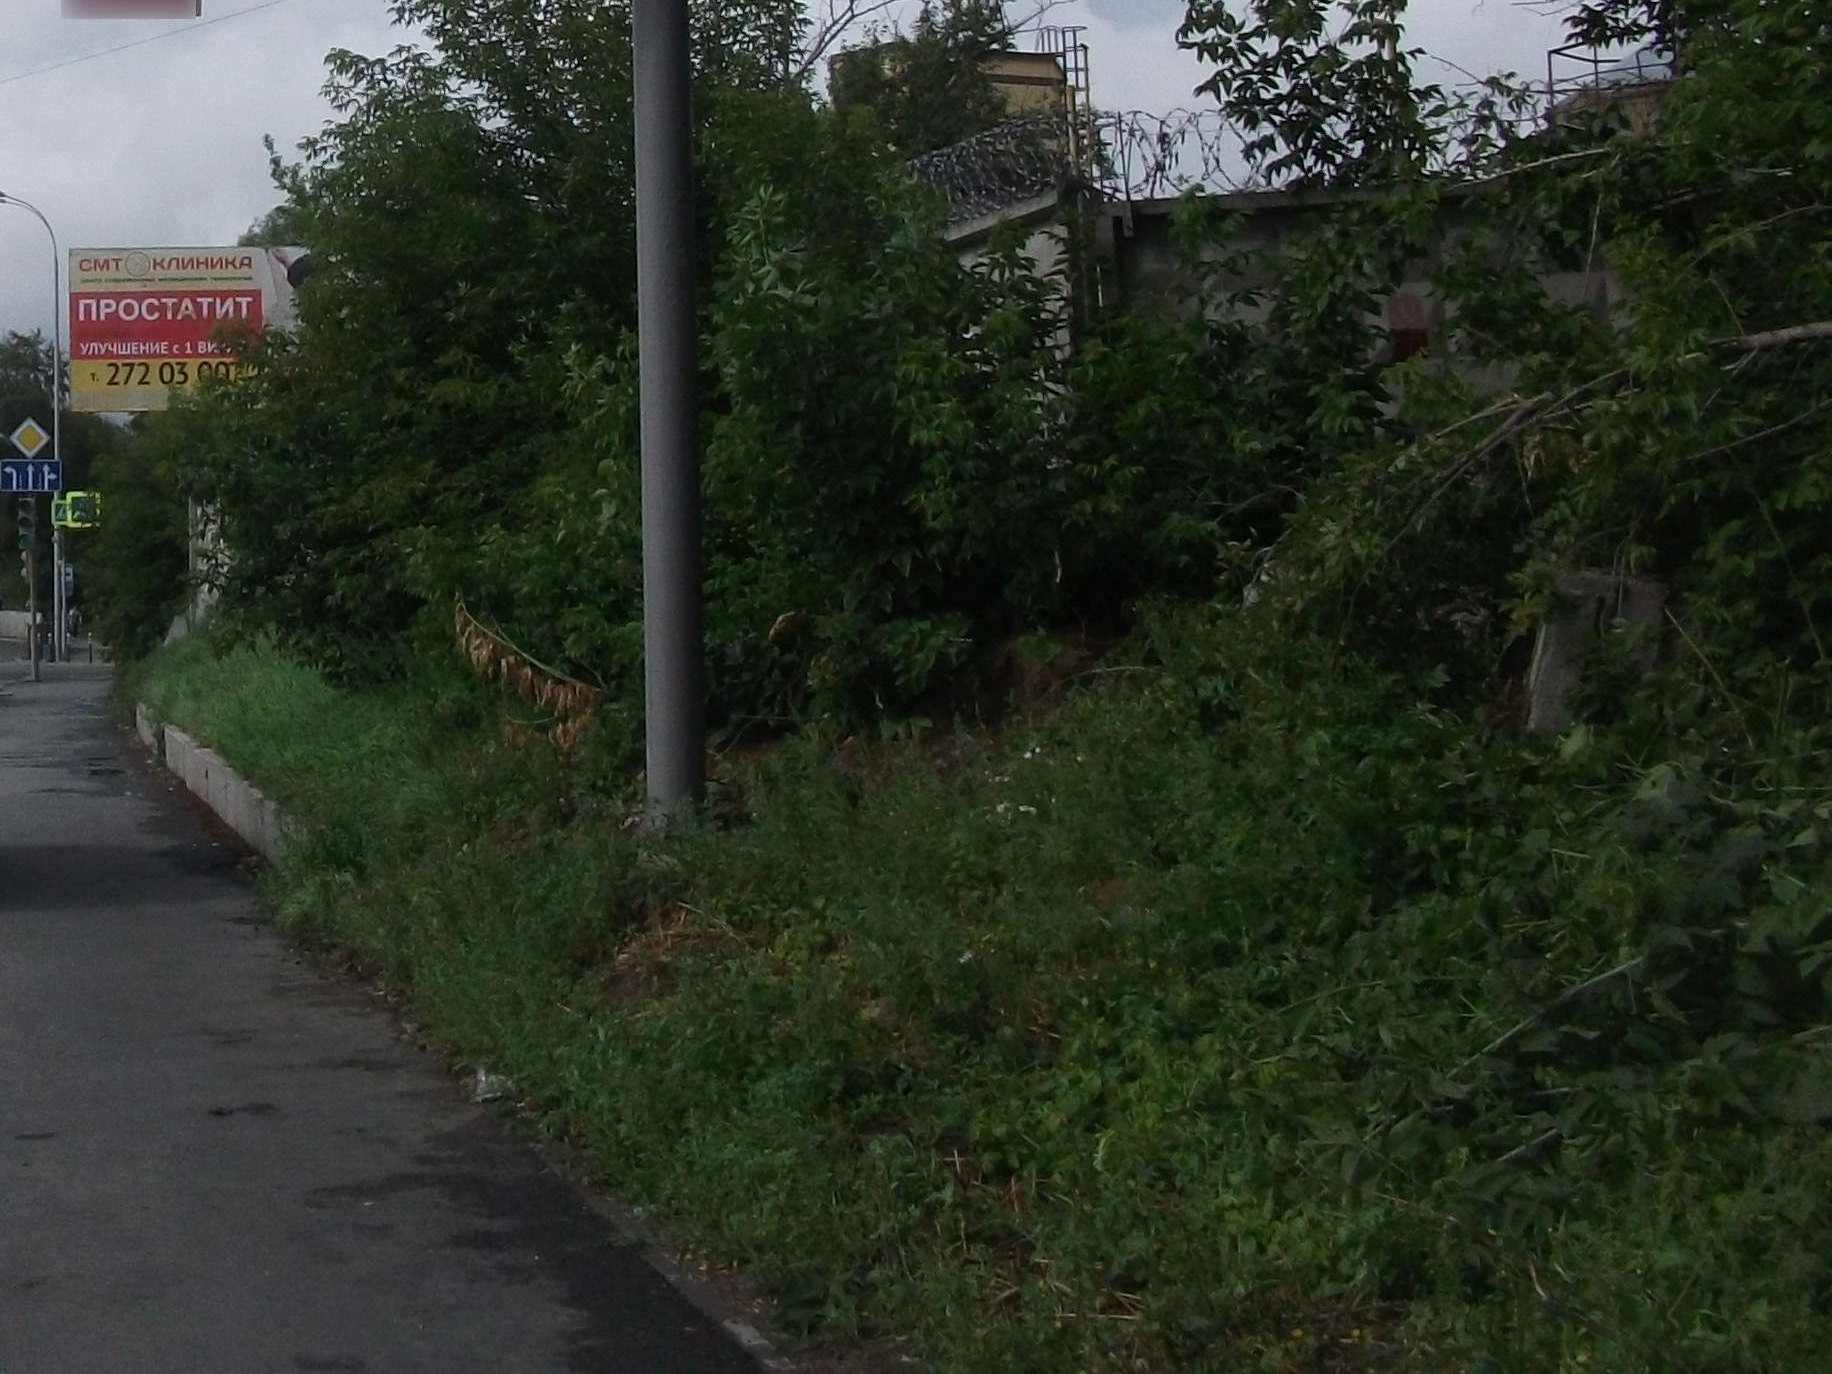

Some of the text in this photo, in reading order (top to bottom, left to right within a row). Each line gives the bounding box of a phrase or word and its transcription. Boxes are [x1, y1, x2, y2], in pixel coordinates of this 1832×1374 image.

[79, 256, 252, 272] СМТ КЛИНИКА
[78, 297, 253, 322] ПРОСТАТИТ
[80, 342, 168, 355] УЛУЧШЕНИЕ
[184, 342, 192, 354] 1
[106, 362, 150, 386] 272
[159, 361, 189, 385] 03
